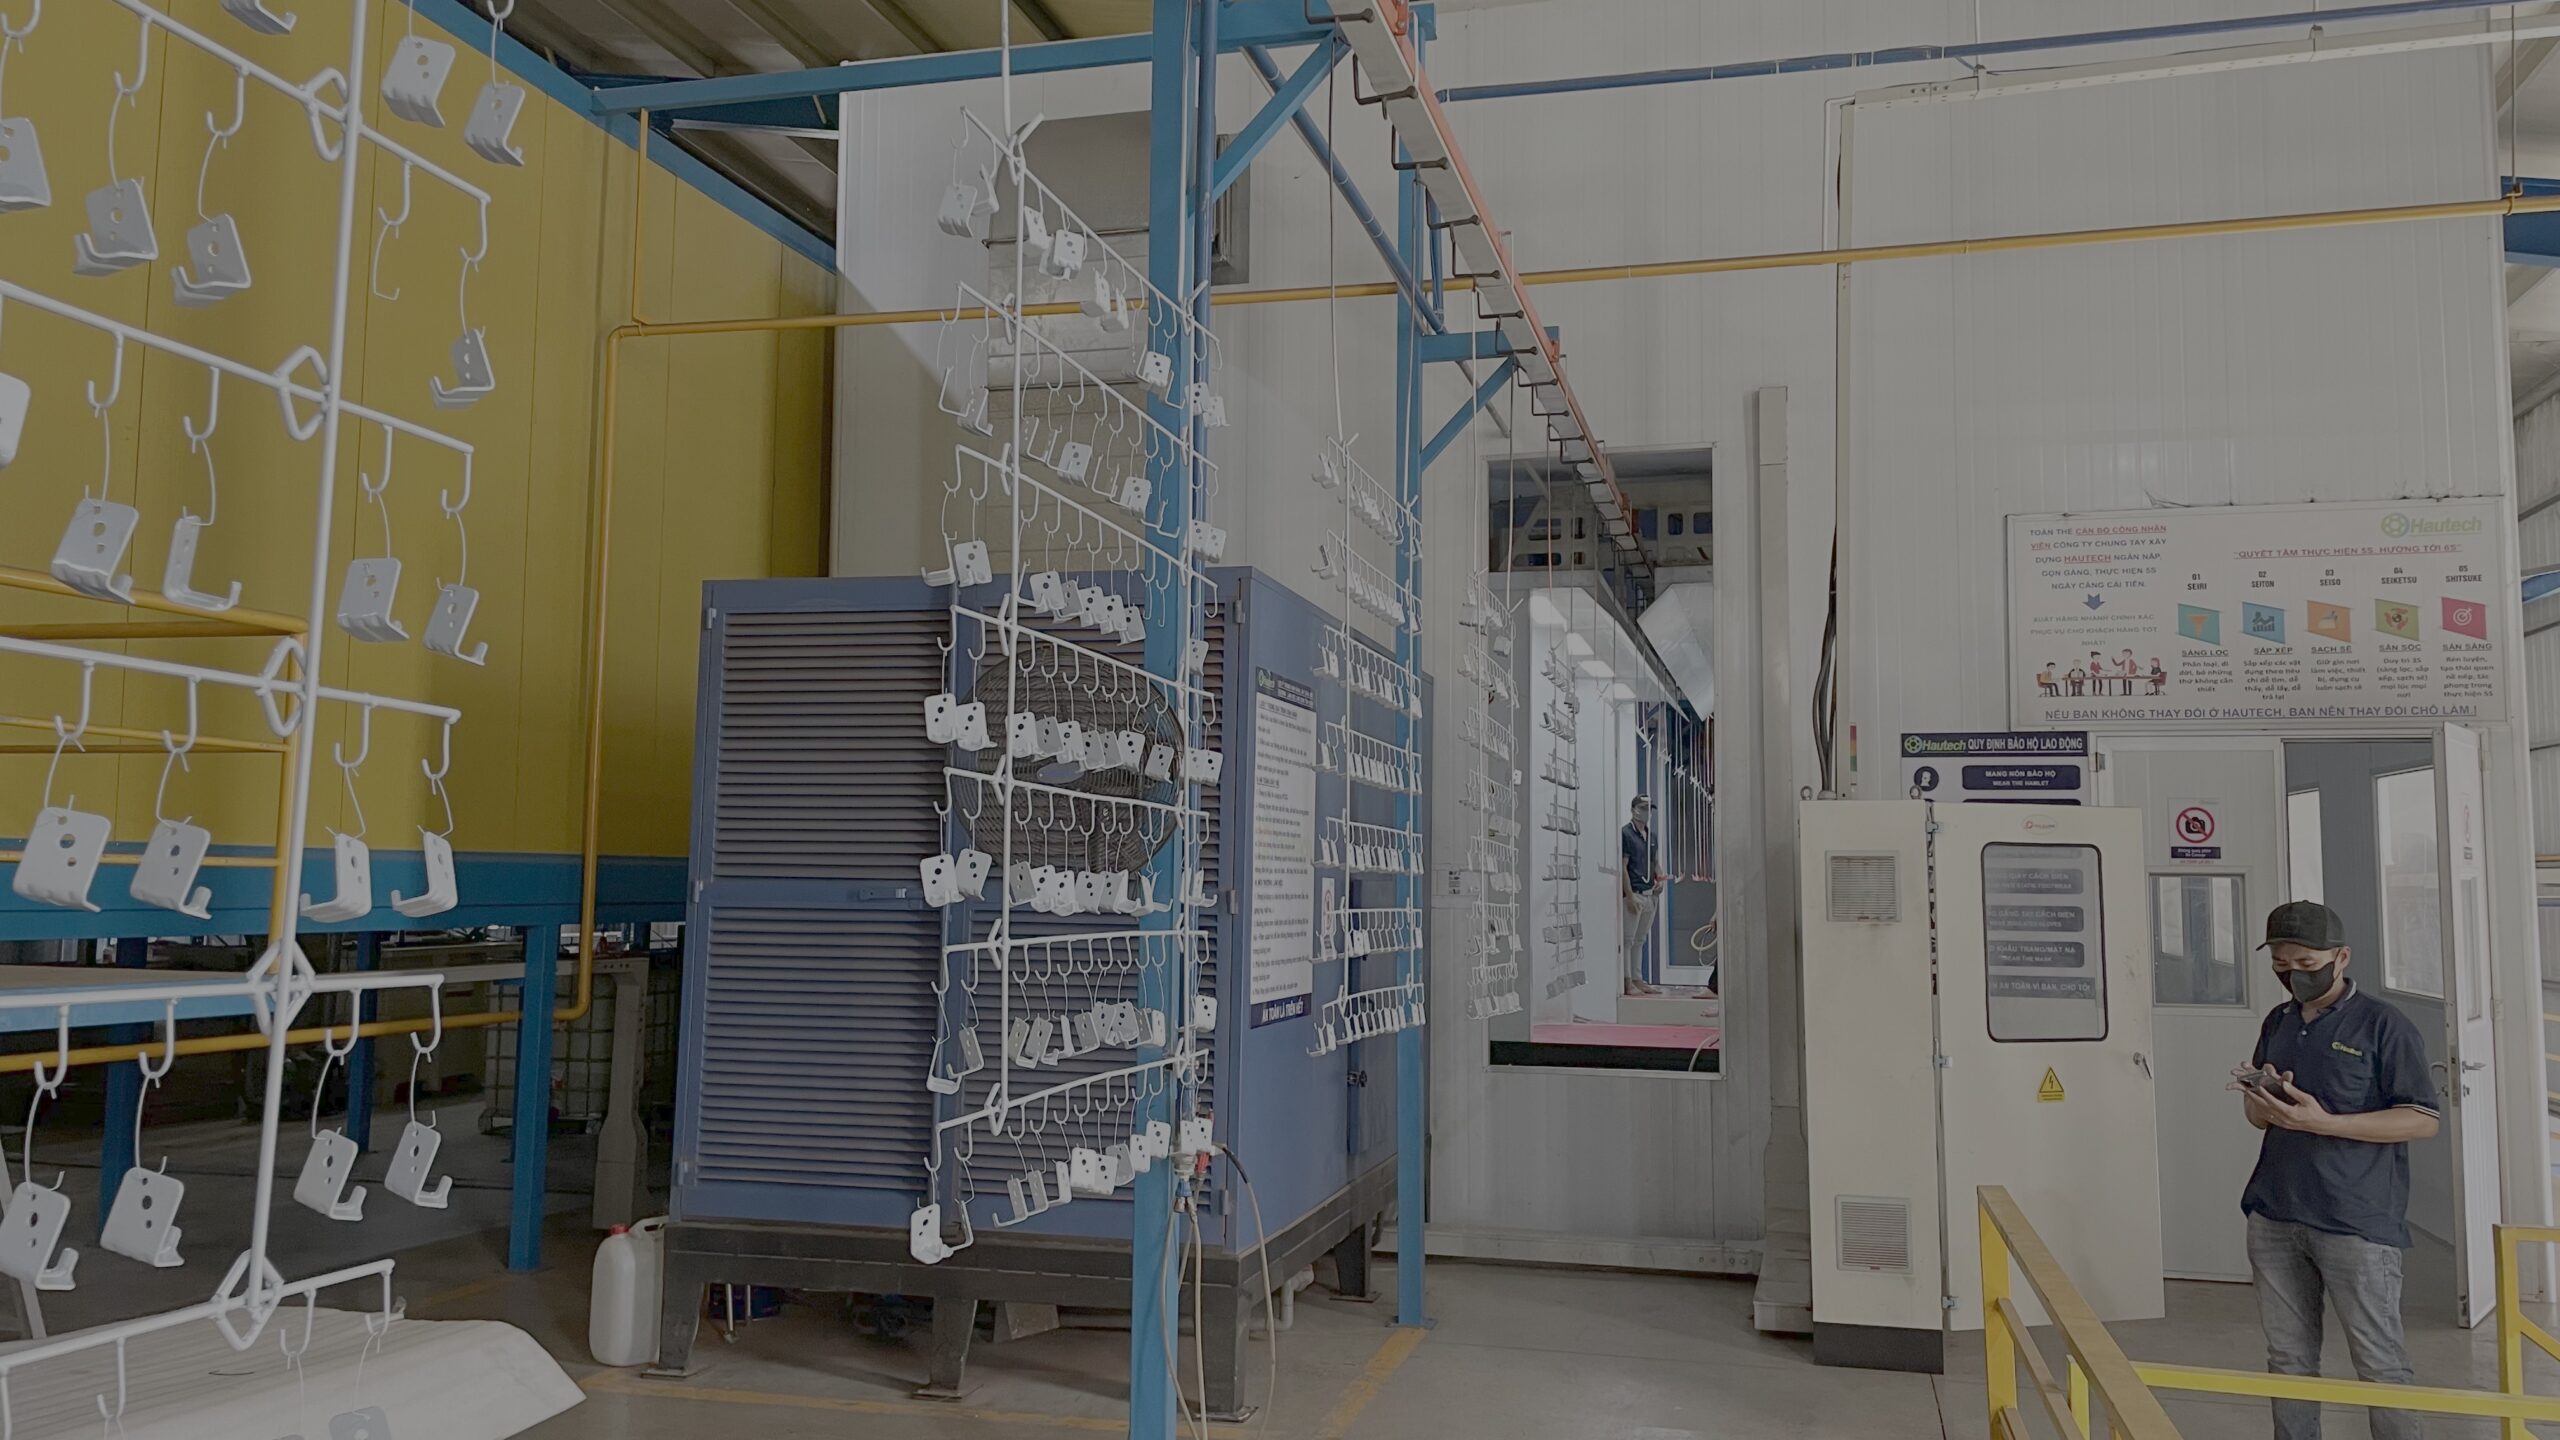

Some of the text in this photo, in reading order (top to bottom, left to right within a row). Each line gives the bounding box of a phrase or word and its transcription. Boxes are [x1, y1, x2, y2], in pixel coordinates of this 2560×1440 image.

[2411, 516, 2482, 533] Hautech
[2064, 554, 2112, 563] HAUTECH
[2325, 569, 2335, 577] 03
[2394, 567, 2404, 575] 04
[2458, 565, 2469, 573] 05
[2192, 573, 2201, 581] 01
[2381, 576, 2418, 585] SEIKETSU
[2445, 574, 2483, 583] SHITSUKE
[2187, 583, 2208, 591] SEIRI
[2251, 580, 2275, 588] SEITON
[2319, 579, 2341, 587] SEISO
[2101, 708, 2145, 719] KHÔNG
[2150, 709, 2181, 718] THAY
[2320, 705, 2345, 717] NÊN
[2349, 706, 2381, 716] THAY
[1922, 736, 2083, 752] Hautech QUY ĐỊNH BẢO HỘ LAO ĐỘNG
